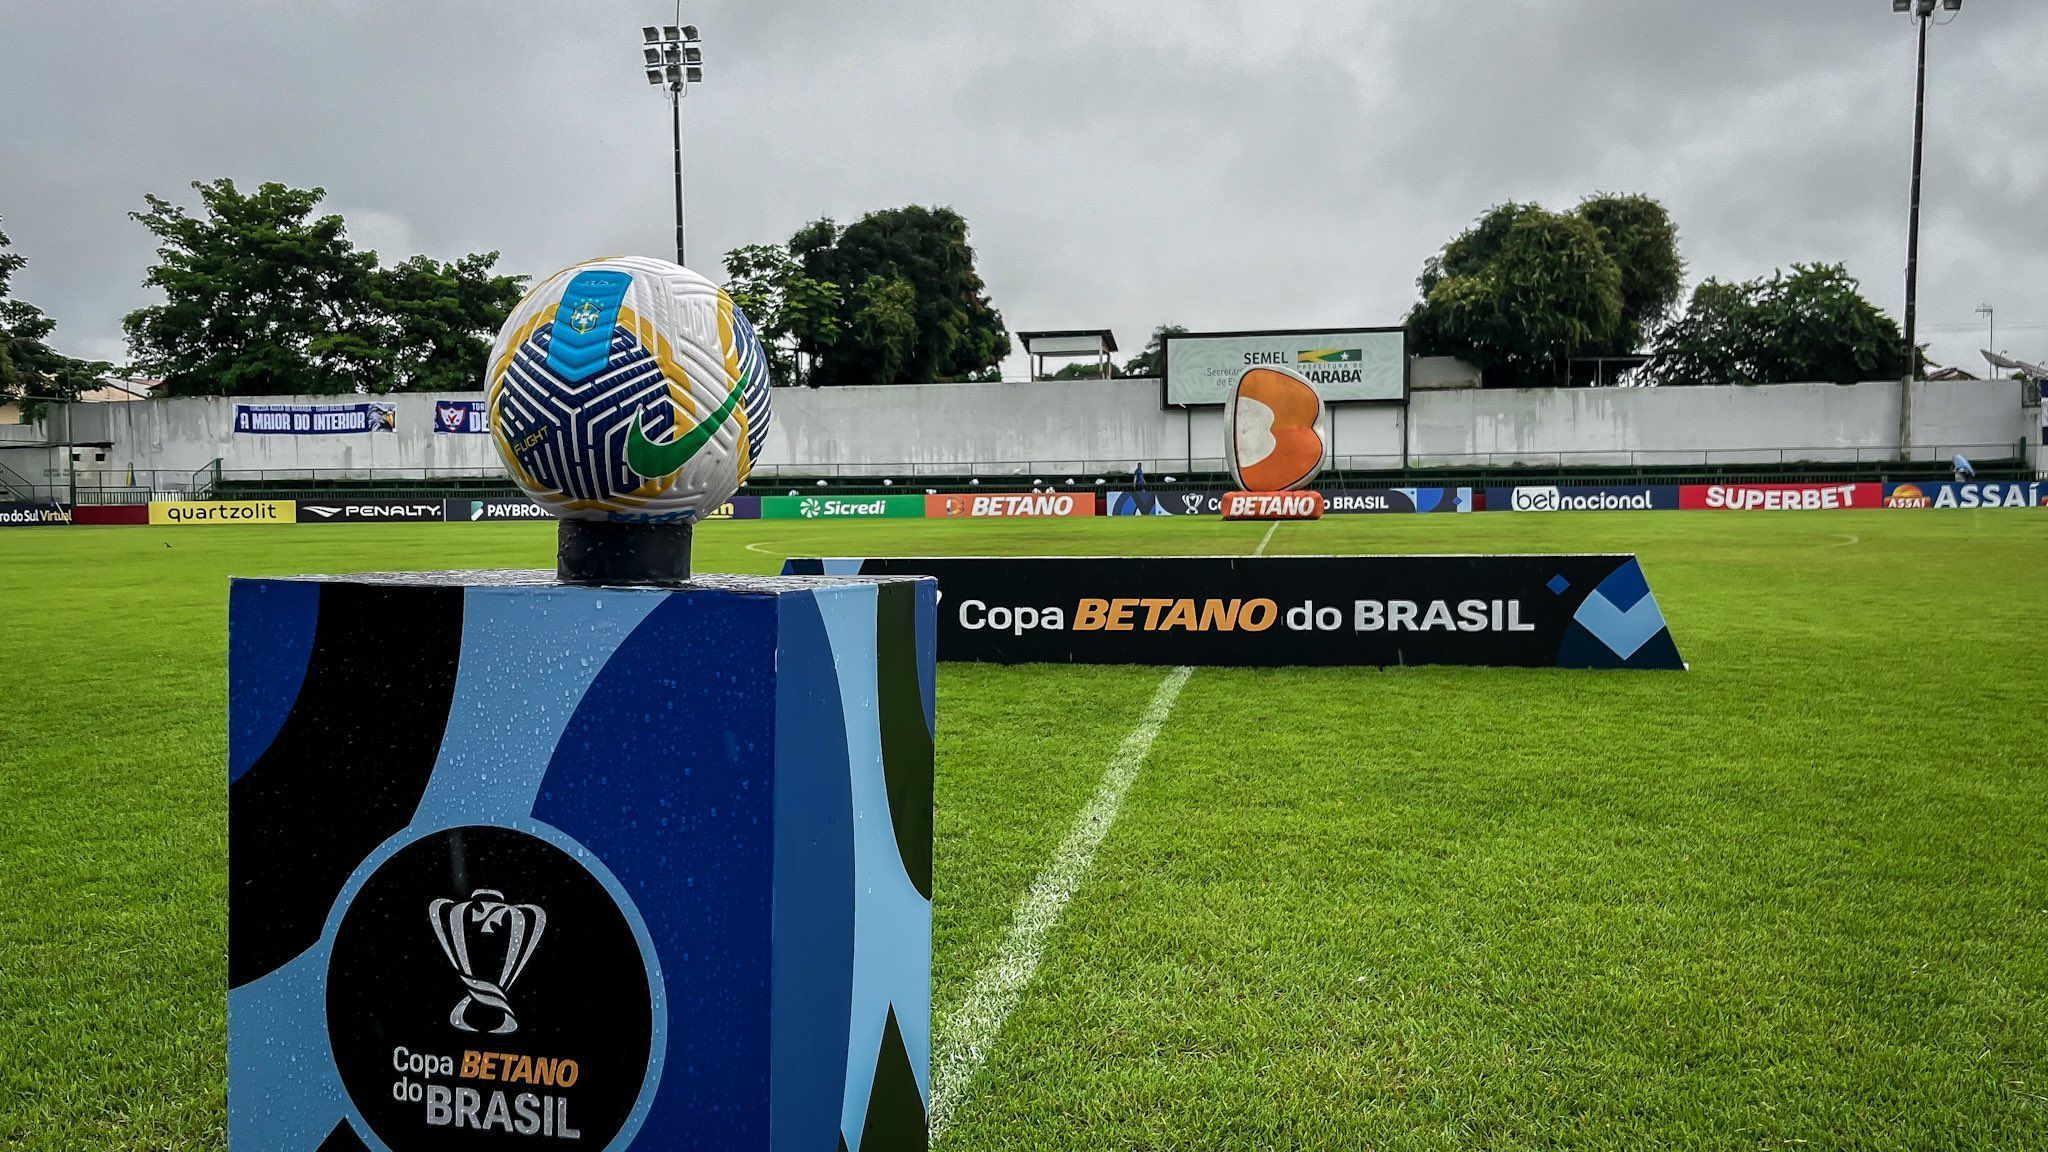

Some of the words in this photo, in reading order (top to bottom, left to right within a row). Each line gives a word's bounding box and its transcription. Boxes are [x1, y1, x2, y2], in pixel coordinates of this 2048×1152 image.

[1244, 352, 1288, 364] SEMEL
[240, 412, 249, 430] A
[252, 412, 291, 430] MAIOR
[294, 413, 311, 430] DO
[314, 411, 366, 430] INTERIOR
[513, 425, 549, 456] FLIGHT
[971, 495, 1074, 517] BETANO
[1230, 495, 1315, 517] BETANO
[1333, 495, 1389, 510] BRASIL
[1705, 484, 1856, 511] SUPERBET
[1933, 481, 2040, 509] ASSAÍ
[11, 509, 24, 522] do
[24, 509, 39, 522] Sul
[168, 503, 277, 522] quartzolit
[345, 505, 441, 517] PENALTY
[824, 498, 886, 516] Sicredi
[958, 600, 1064, 636] Copa
[1072, 598, 1277, 632] BETANO
[1286, 598, 1342, 632] do
[1353, 598, 1536, 632] BRASIL
[392, 1046, 454, 1078] Copa
[459, 1049, 579, 1088] BETANO
[392, 1077, 423, 1102] do
[426, 1084, 581, 1139] BRASIL
